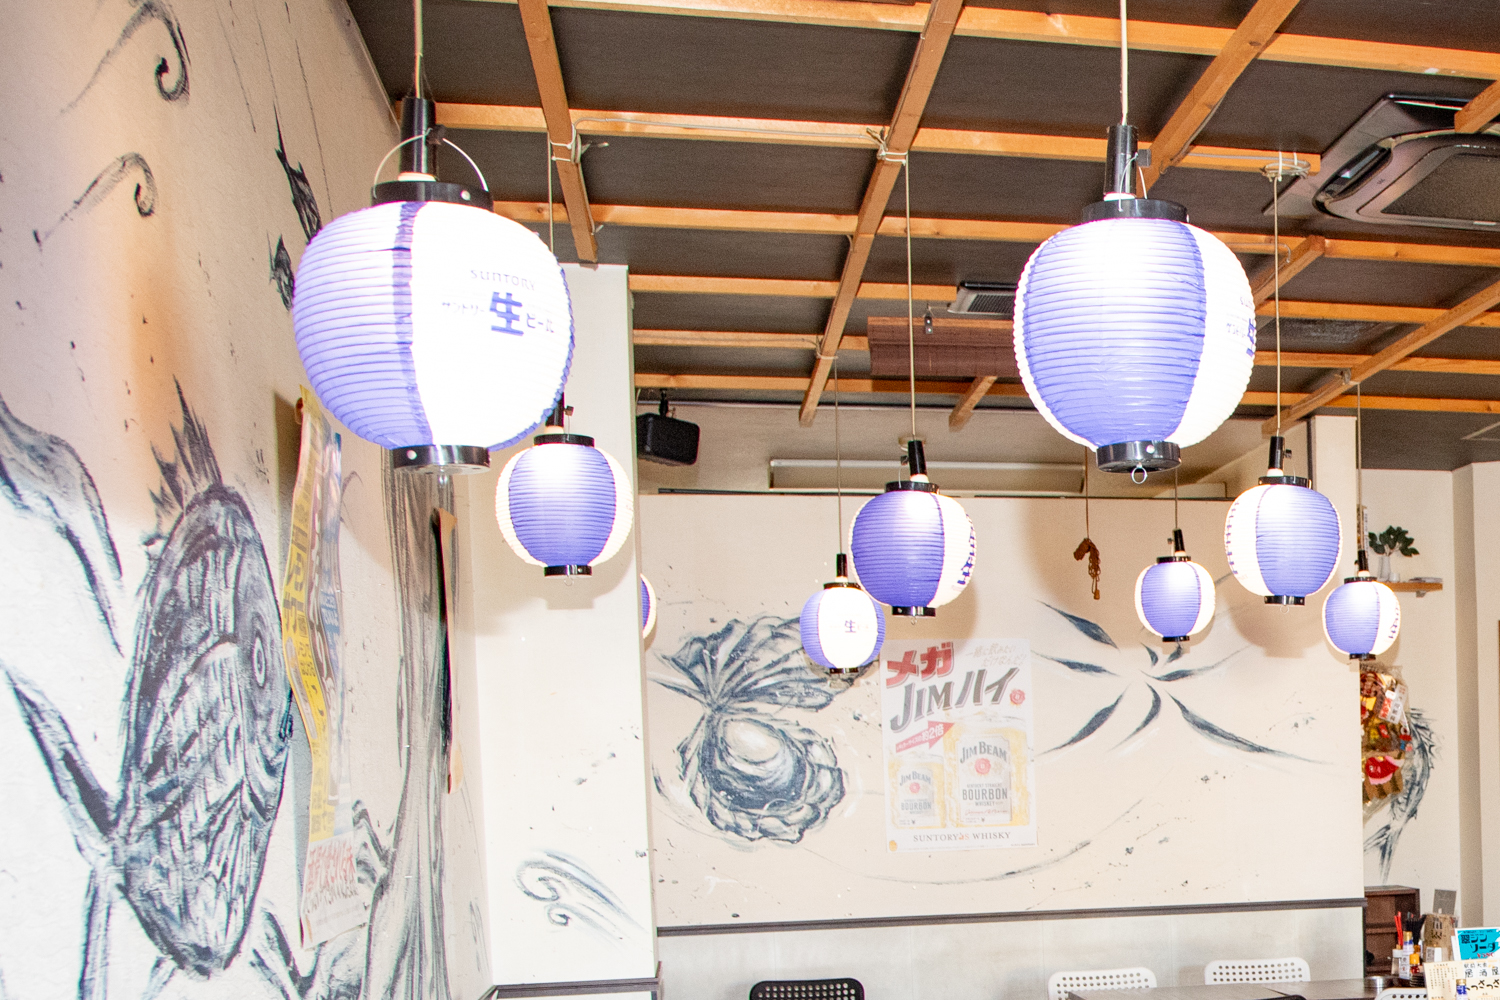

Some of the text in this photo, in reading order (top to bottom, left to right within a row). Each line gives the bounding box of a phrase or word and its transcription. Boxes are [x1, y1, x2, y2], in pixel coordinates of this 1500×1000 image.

[471, 269, 535, 291] SUNTORY
[885, 641, 955, 689] メガ
[960, 741, 1008, 764] JIM BEAM
[962, 788, 1008, 801] BOURBON
[973, 831, 1011, 840] WHISKY
